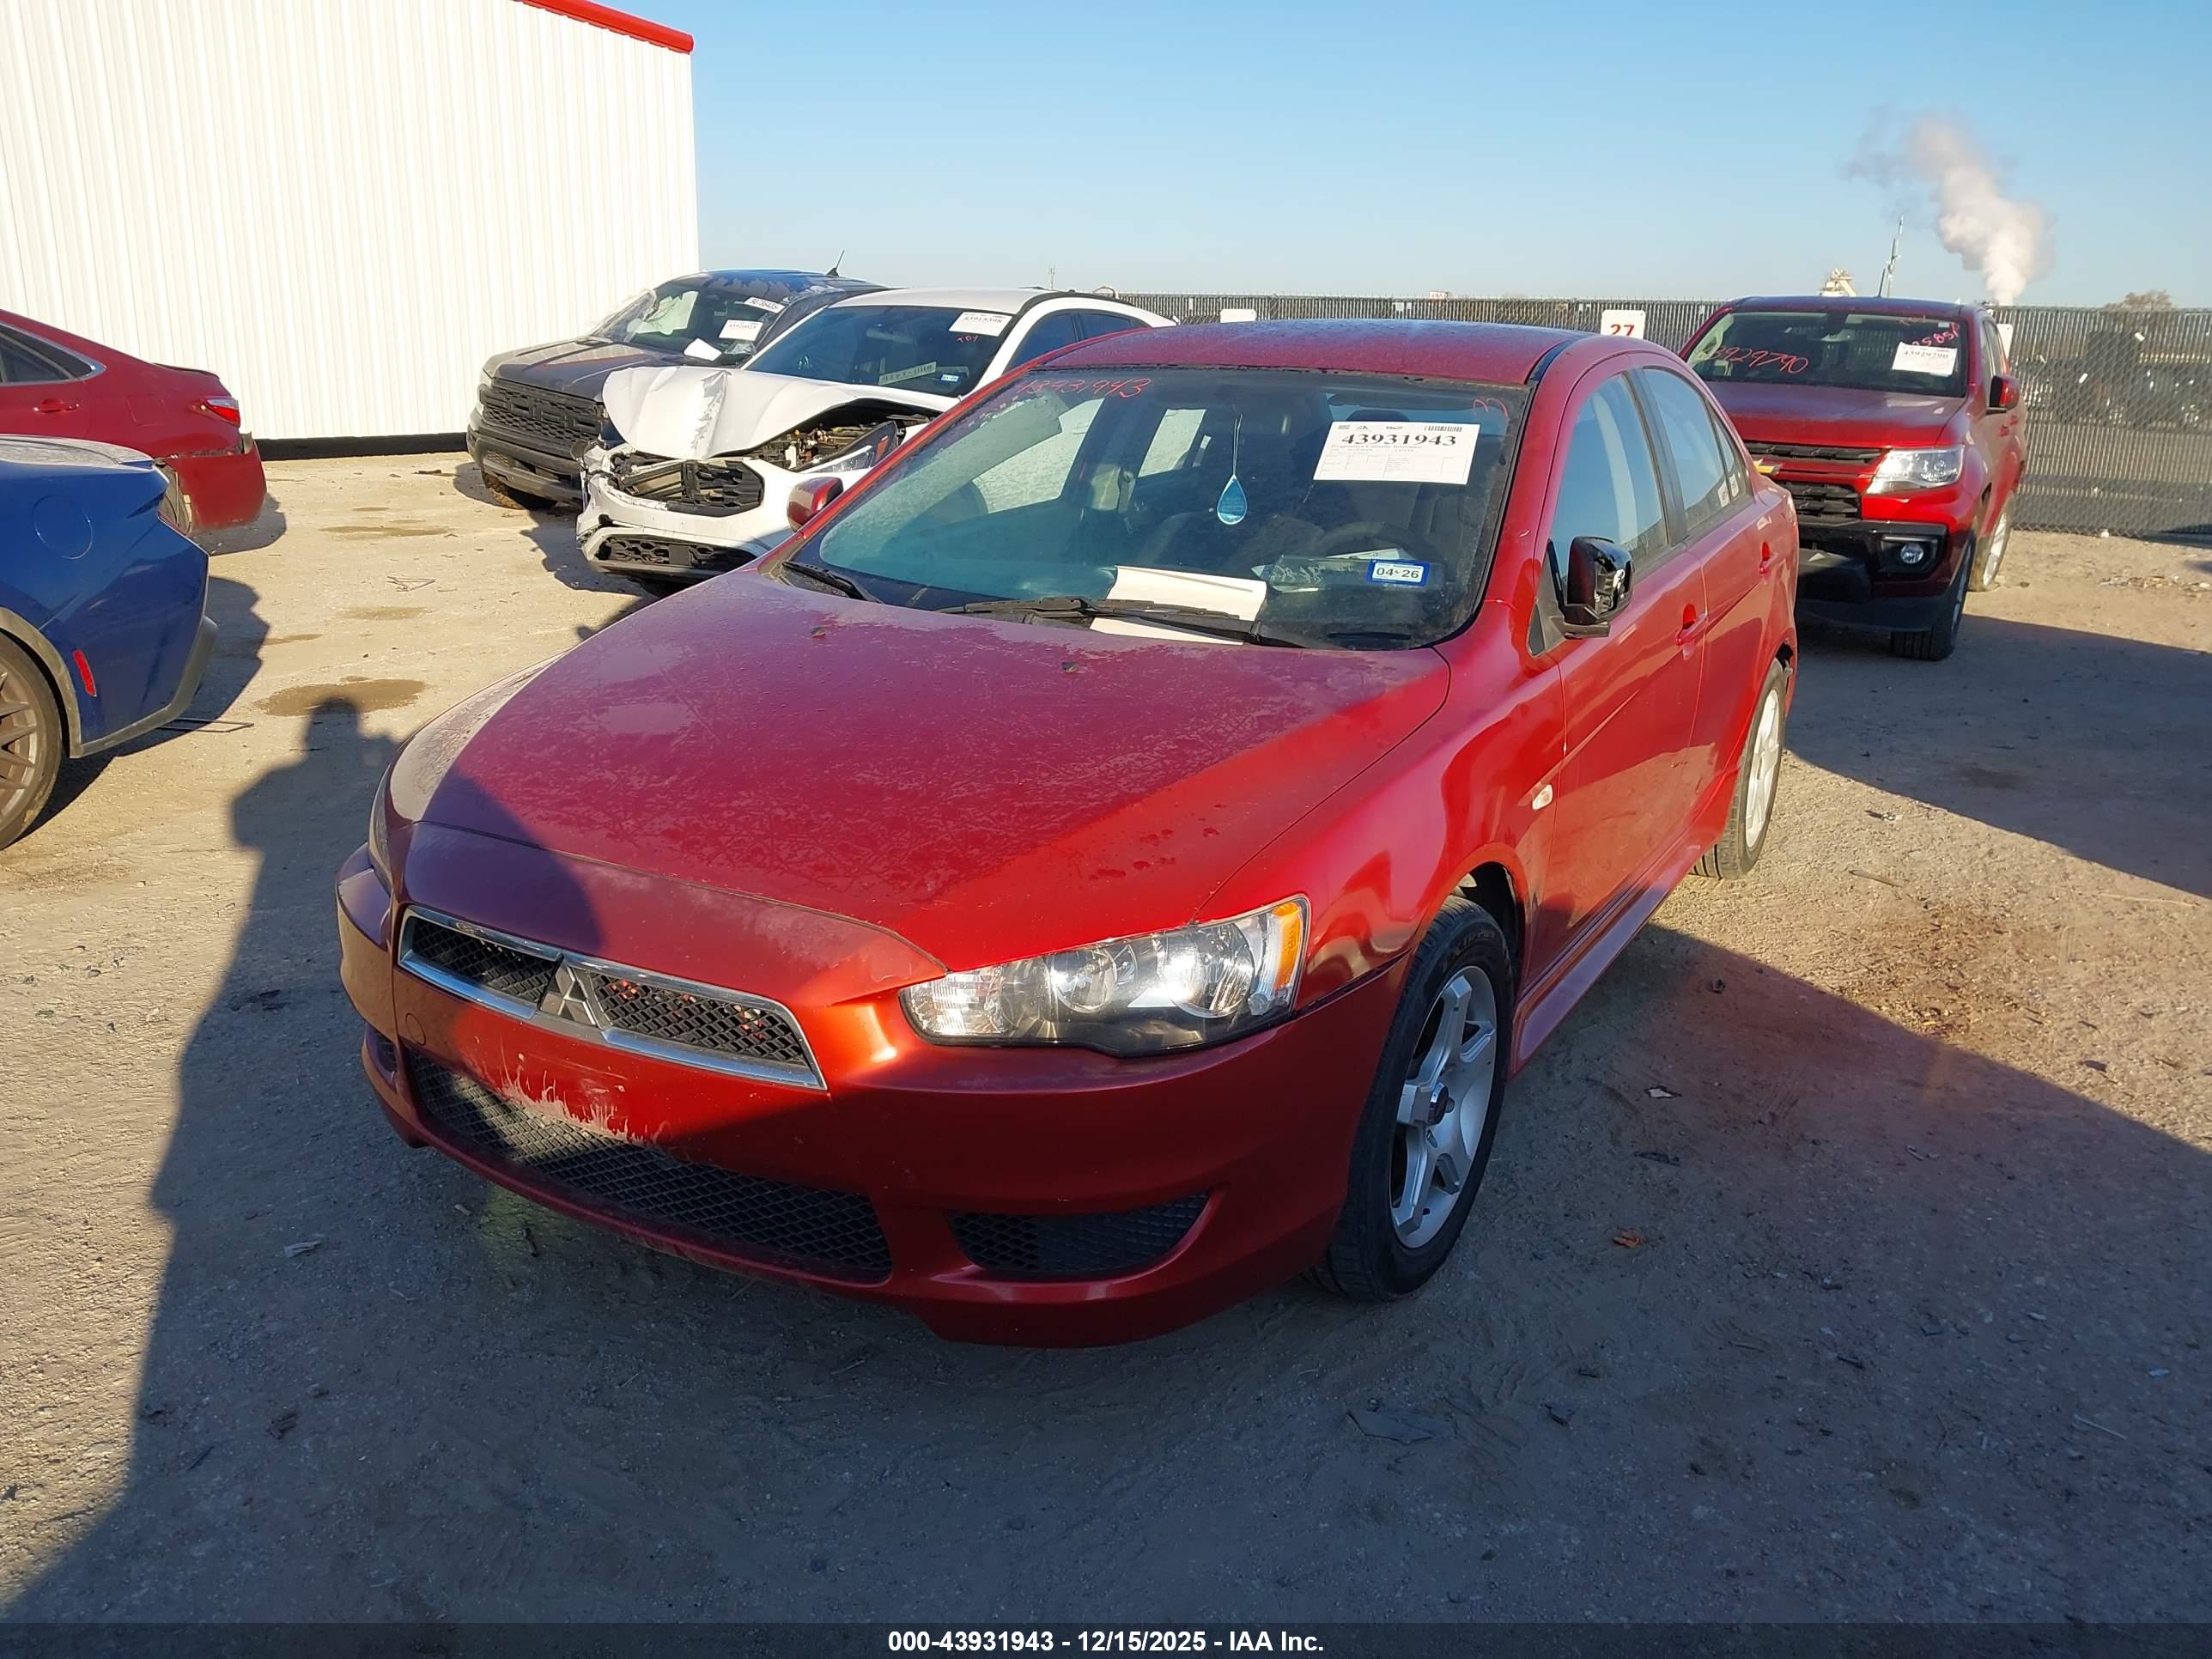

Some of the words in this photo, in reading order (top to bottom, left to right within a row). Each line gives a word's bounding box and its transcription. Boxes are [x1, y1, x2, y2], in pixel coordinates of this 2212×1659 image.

[1610, 324, 1635, 337] 27
[1341, 433, 1457, 447] 43931943
[1376, 567, 1394, 576] 04
[1401, 569, 1420, 579] 26
